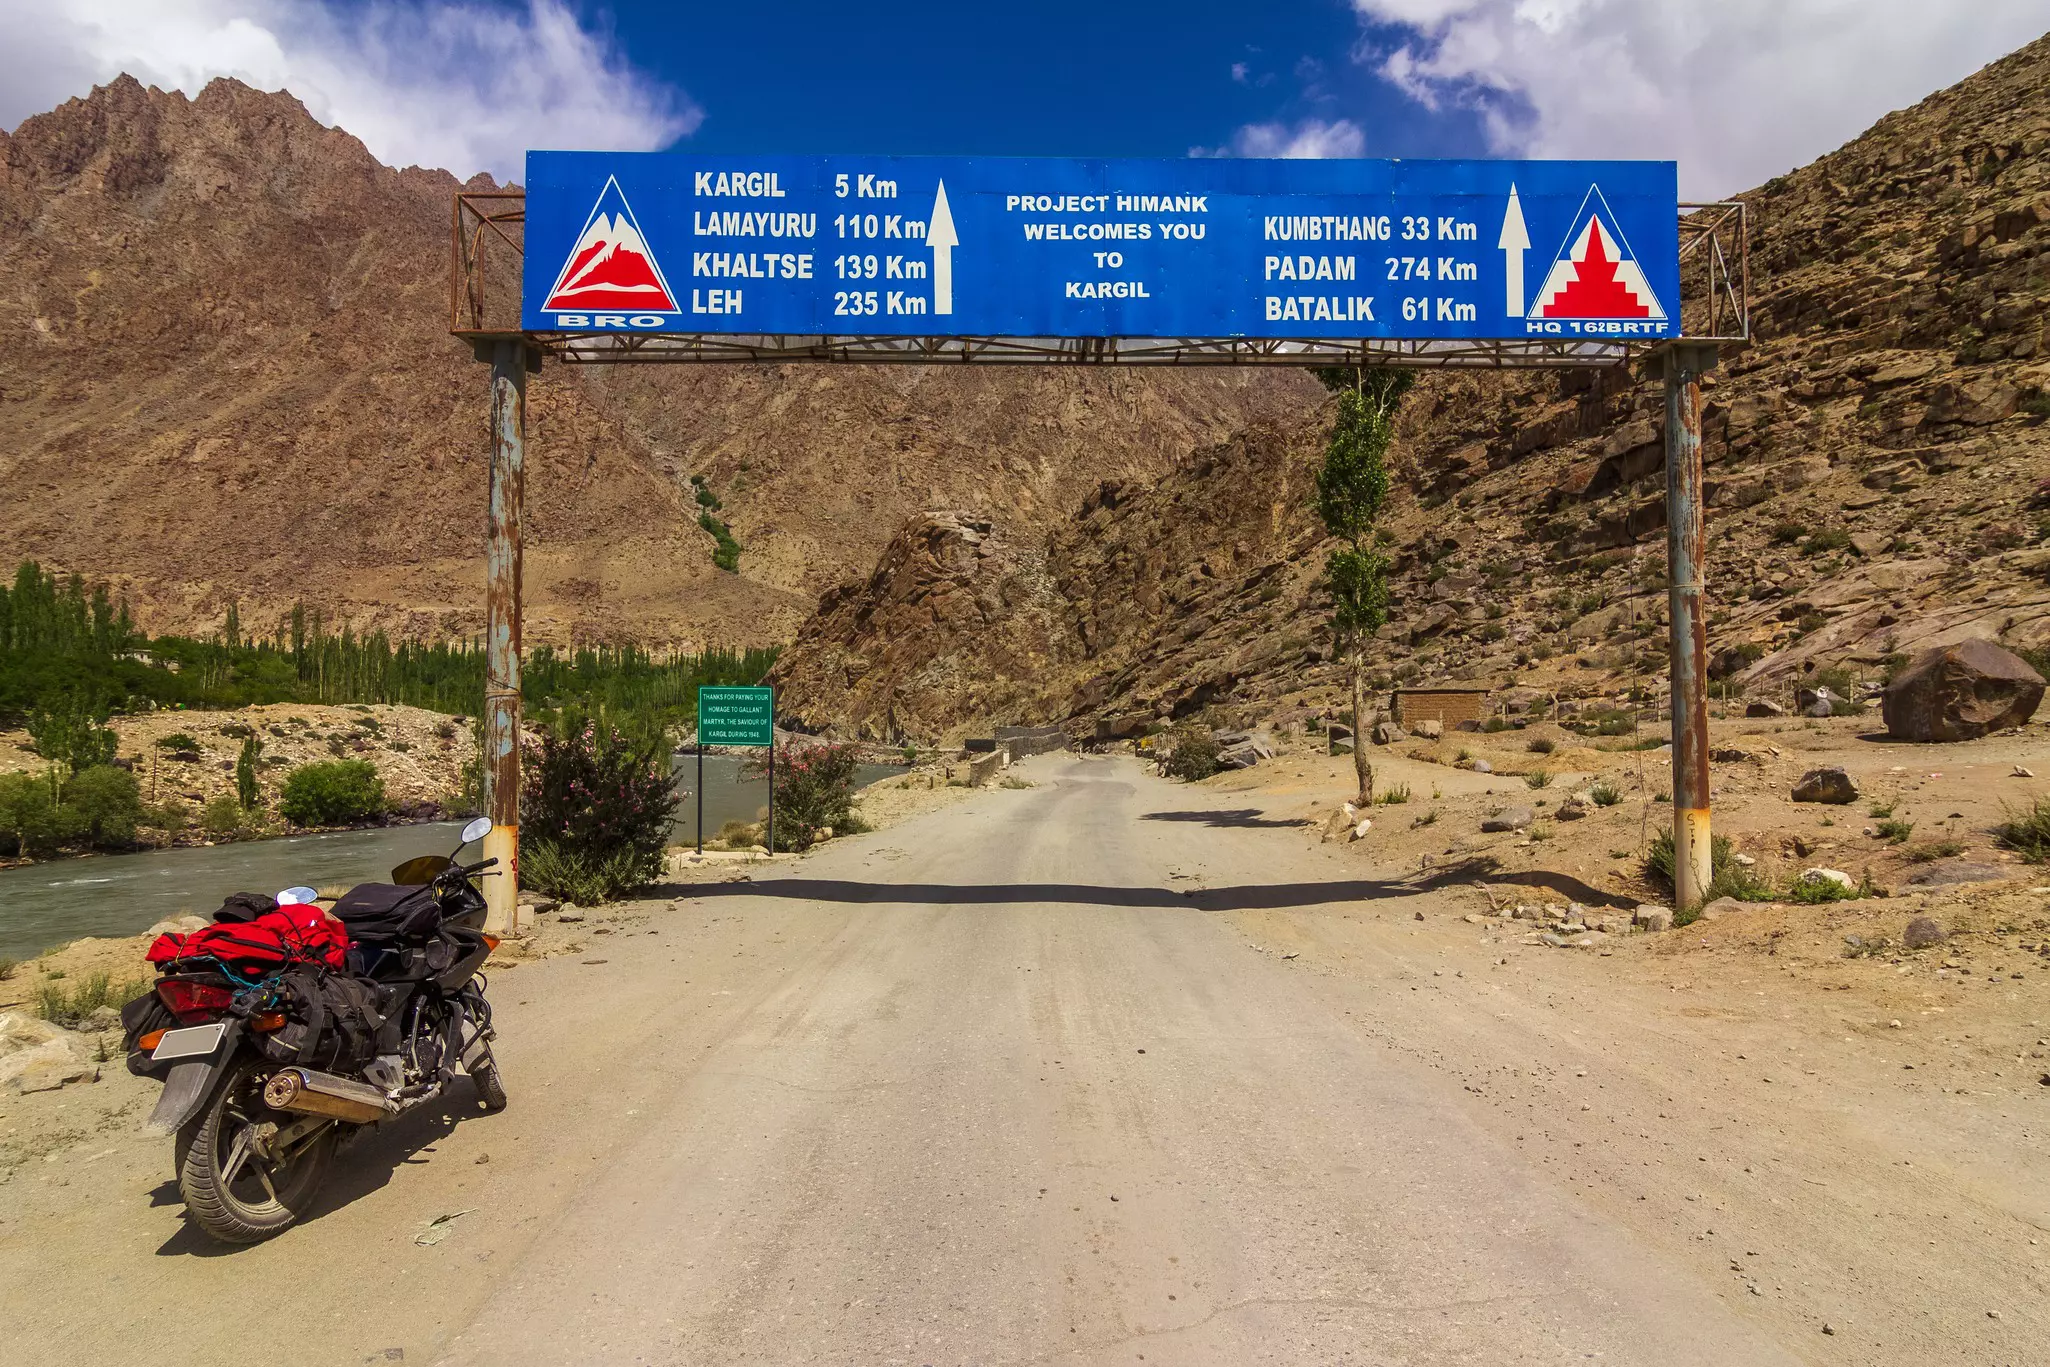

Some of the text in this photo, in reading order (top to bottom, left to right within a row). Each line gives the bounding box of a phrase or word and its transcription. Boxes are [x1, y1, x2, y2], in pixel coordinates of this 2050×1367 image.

[696, 172, 896, 197] KARGIL 5 Km
[1007, 196, 1207, 212] PROJECT HIMANK
[695, 212, 925, 238] LAMAYURU 110 Km
[1024, 224, 1205, 240] WELCOMES YOU
[1265, 216, 1476, 240] KUMBTHANG 33 Km
[694, 253, 926, 278] KHALTSE 139 Km
[1094, 252, 1122, 268] TO
[1266, 256, 1476, 280] PADAM 274 Km
[1066, 282, 1149, 298] KARGIL
[693, 290, 926, 315] LEH 235 Km
[1266, 297, 1475, 320] BATALIK 61 Km
[558, 315, 664, 327] BRO
[1526, 322, 1562, 334] HQ
